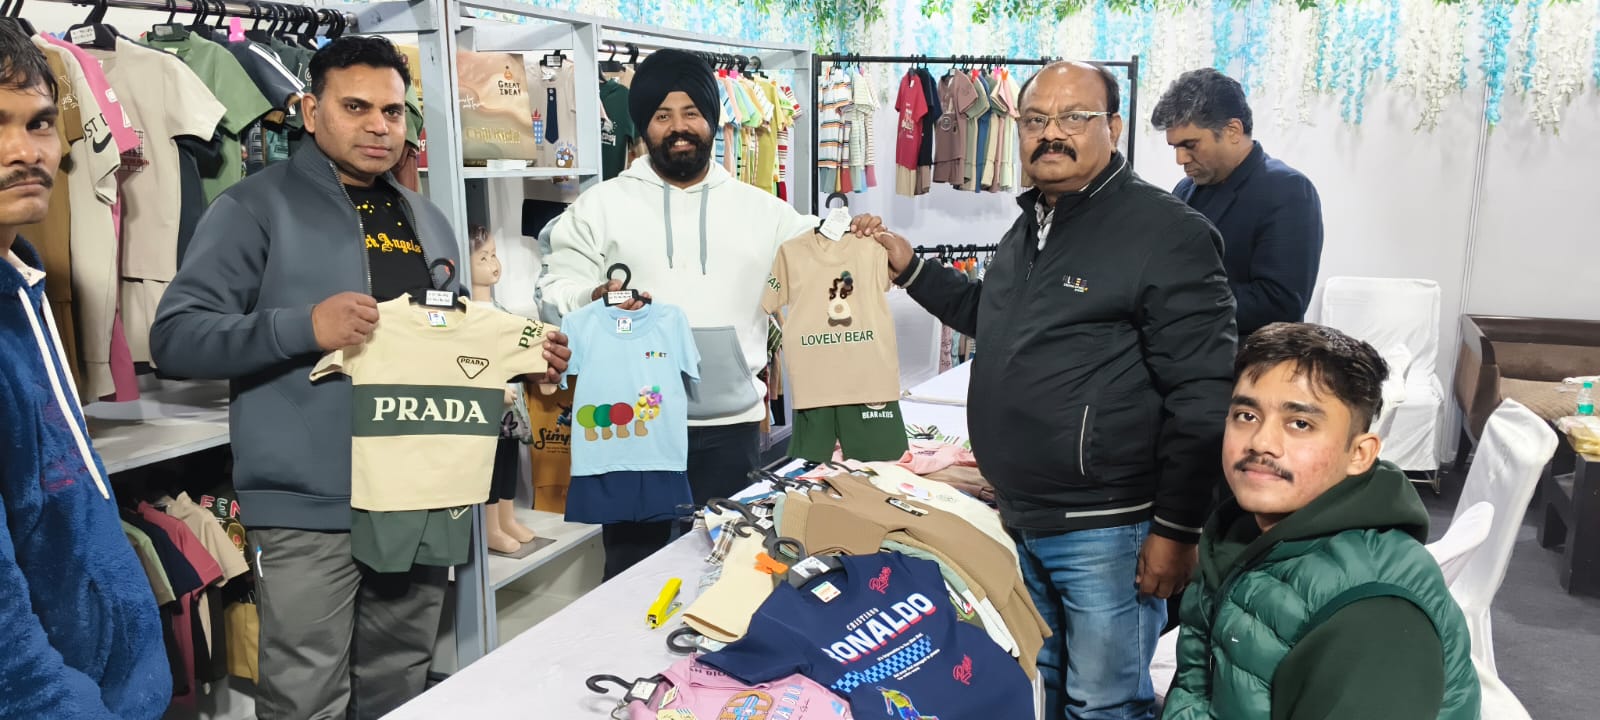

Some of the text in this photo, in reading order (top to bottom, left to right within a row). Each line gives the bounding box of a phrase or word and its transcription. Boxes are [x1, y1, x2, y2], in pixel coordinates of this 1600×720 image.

[767, 273, 782, 293] AR
[801, 330, 874, 346] LOVELY BEAR
[460, 358, 484, 367] PRADA
[371, 396, 489, 424] PRADA
[846, 607, 880, 631] CRISTIANO
